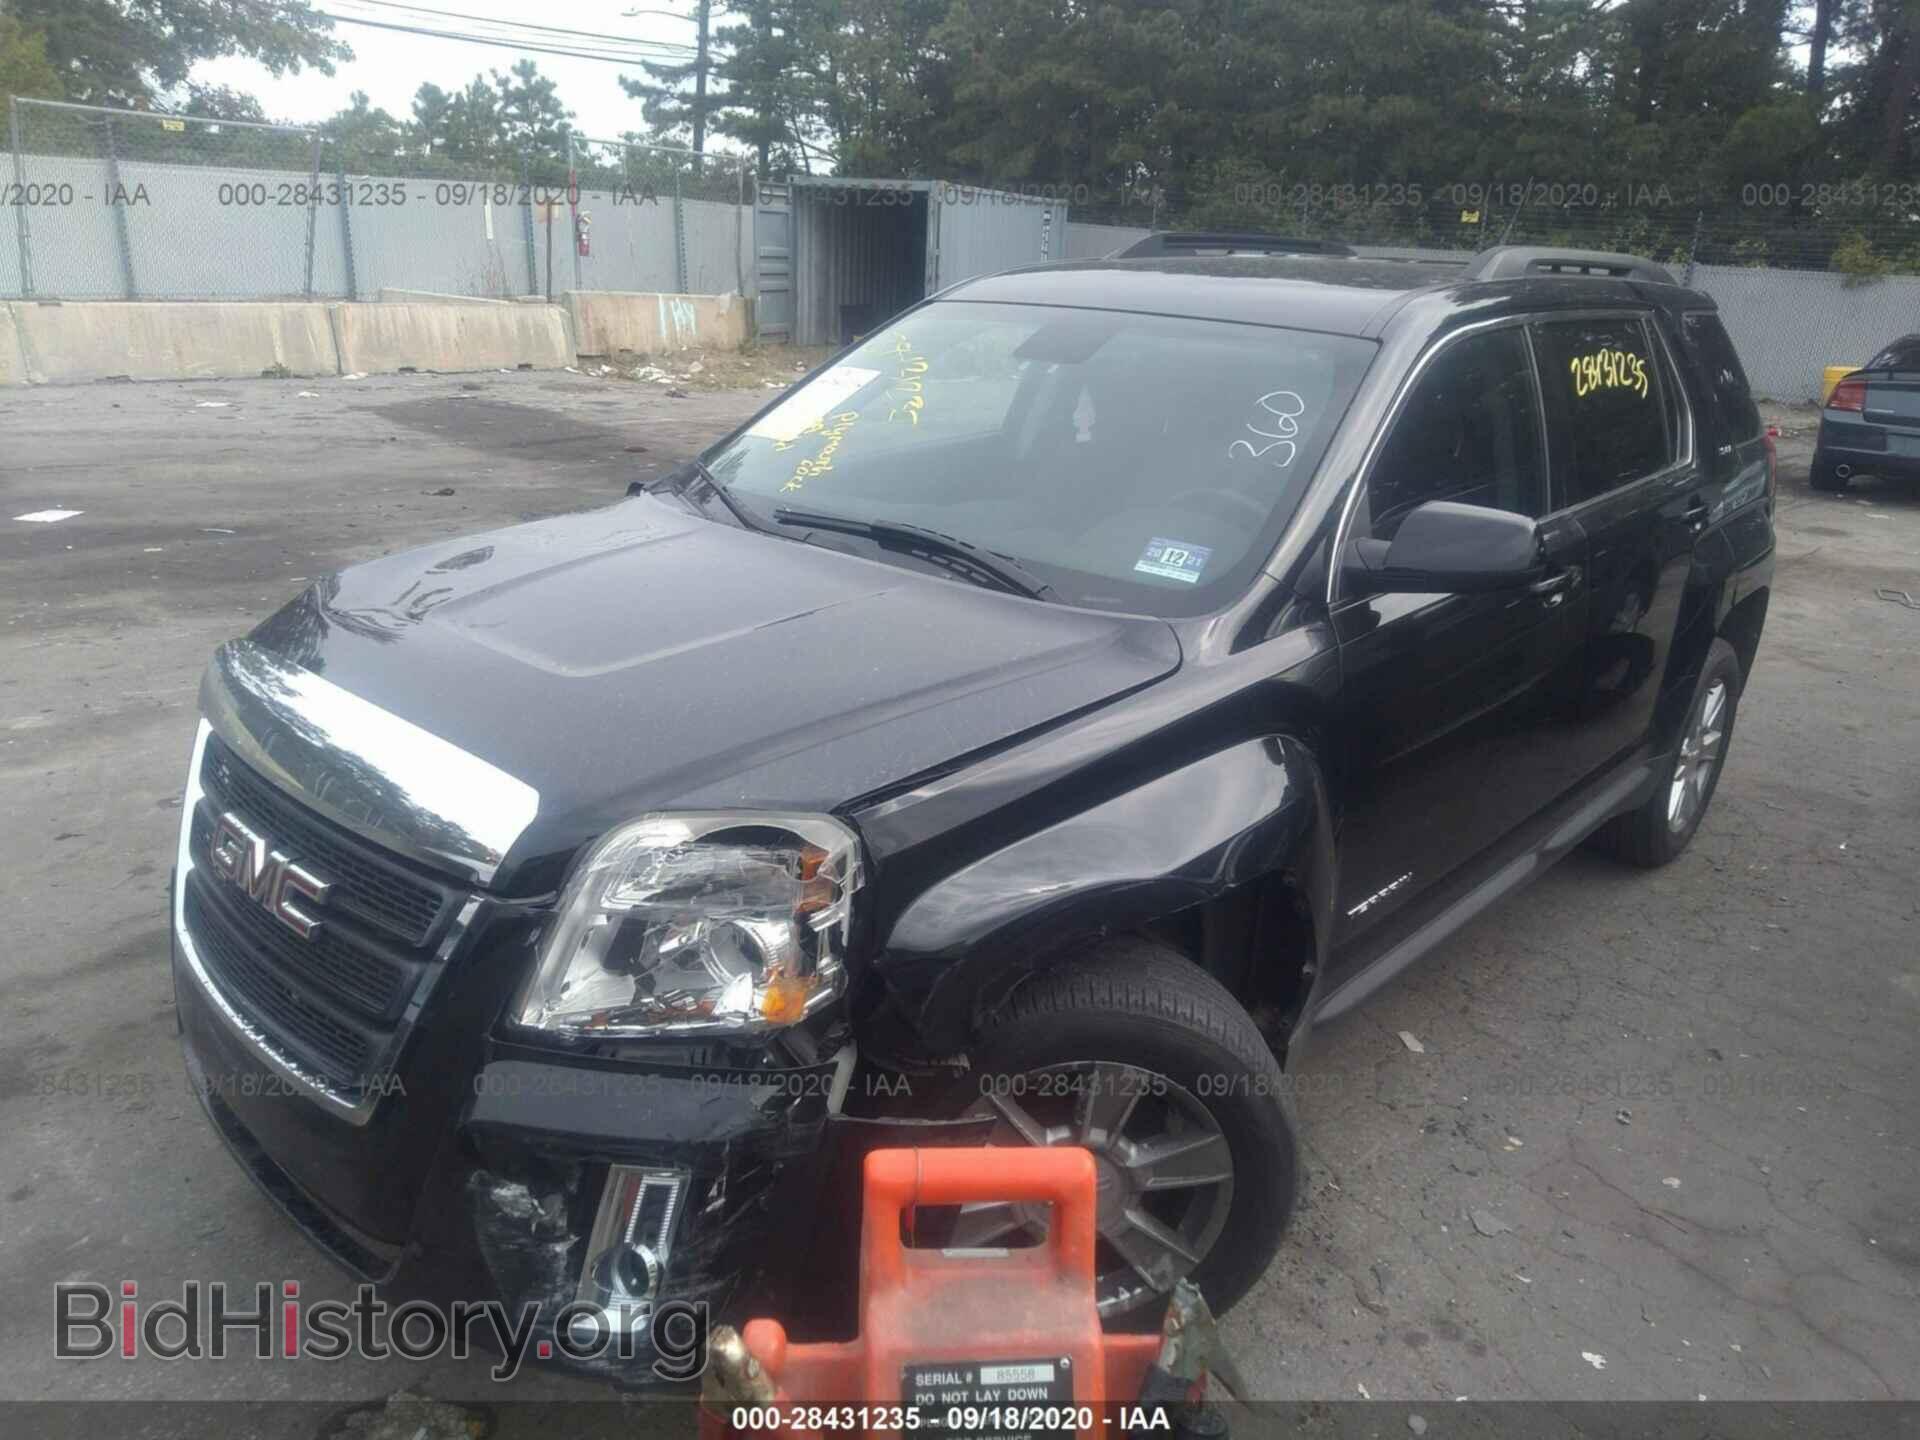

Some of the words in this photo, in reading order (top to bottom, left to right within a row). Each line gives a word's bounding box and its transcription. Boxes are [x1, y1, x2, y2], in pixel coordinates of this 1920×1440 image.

[1228, 391, 1305, 467] 360
[211, 812, 331, 939] GMC
[915, 1372, 963, 1387] SERIAL
[915, 1392, 935, 1406] DO
[941, 1390, 969, 1403] NOT
[975, 1389, 1001, 1402] LAY
[1007, 1387, 1049, 1401] DOWN
